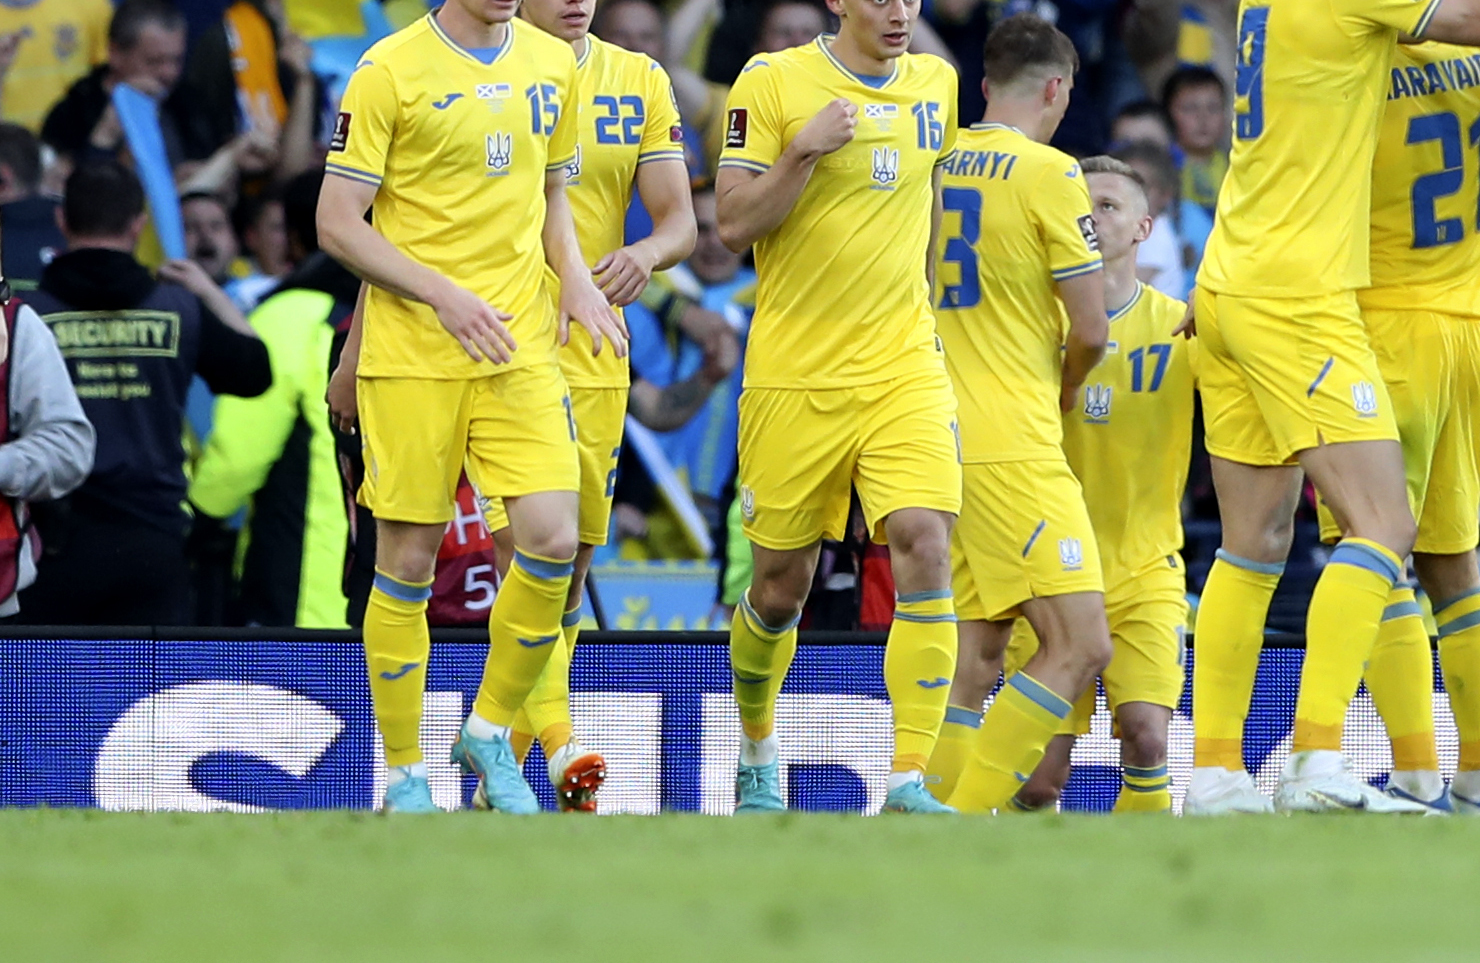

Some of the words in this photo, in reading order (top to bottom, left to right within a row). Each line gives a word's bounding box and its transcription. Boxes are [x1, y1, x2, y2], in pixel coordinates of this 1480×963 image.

[1235, 5, 1271, 142] 9
[524, 83, 559, 136] 15
[593, 95, 645, 145] 22
[53, 320, 168, 347] SECURITY
[1128, 343, 1172, 392] 17
[464, 564, 501, 610] 5
